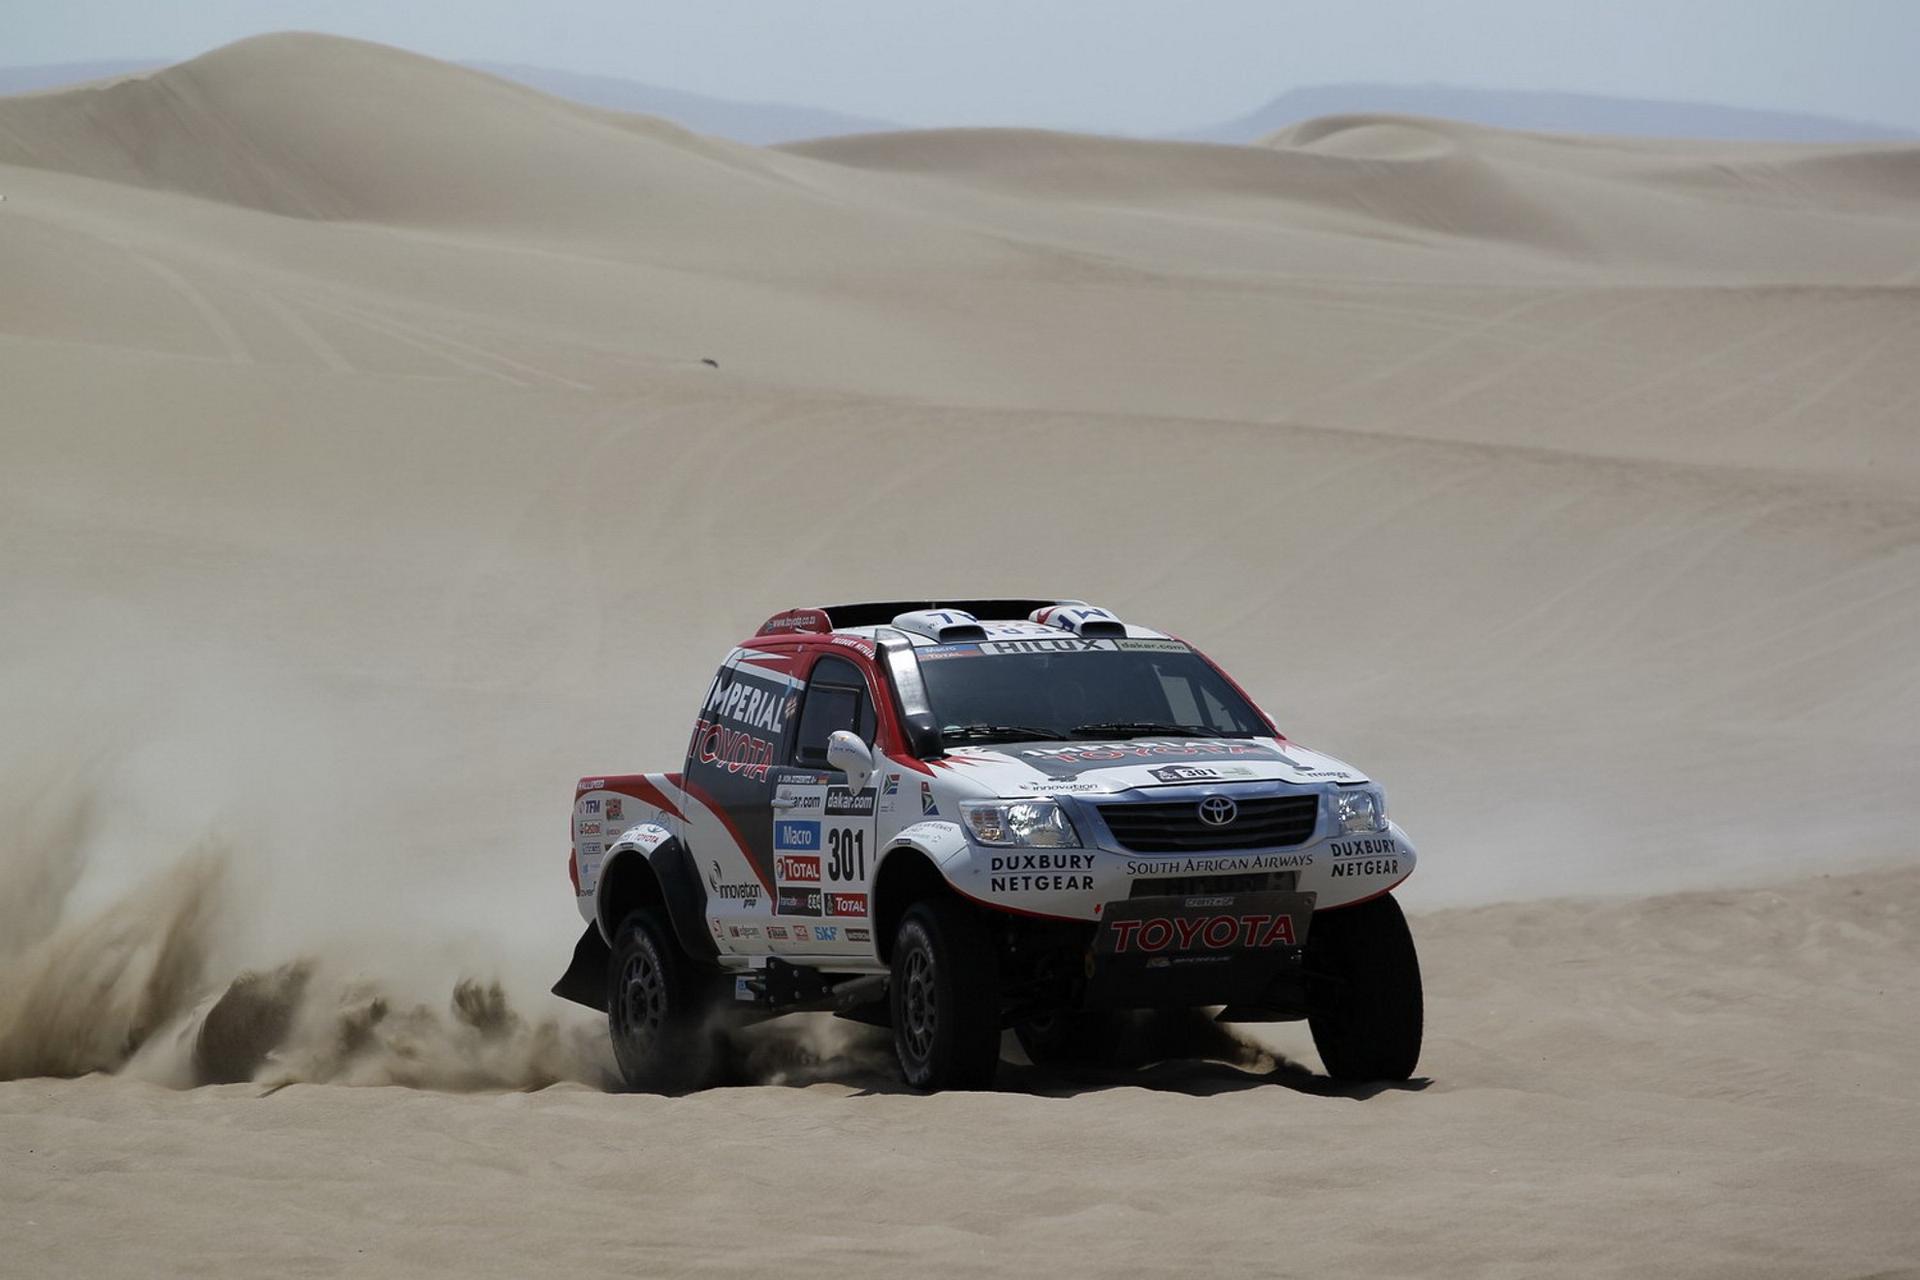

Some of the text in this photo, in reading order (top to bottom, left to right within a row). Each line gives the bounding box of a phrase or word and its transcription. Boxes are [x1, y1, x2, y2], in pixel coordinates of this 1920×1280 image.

[991, 639, 1105, 654] HILUX
[1121, 642, 1185, 651] dakar.com
[702, 675, 786, 734] IMPERIAL
[688, 718, 774, 784] TOYOTA
[1182, 768, 1217, 777] 301
[827, 790, 873, 809] dakar.com
[782, 825, 812, 845] Macro
[827, 828, 865, 881] 301
[1330, 839, 1397, 857] DUXBURY
[785, 859, 820, 879] TOTAL
[991, 854, 1095, 872] DUXBURY
[1126, 853, 1314, 875] SOUTH AFRICAN AIRWAYS
[1330, 859, 1399, 877] NETGEAR
[719, 882, 762, 899] innovation
[991, 875, 1095, 892] NETGEAR
[835, 896, 866, 912] TOTAL
[814, 926, 839, 941] SKF
[1111, 914, 1297, 953] TOYOTA
